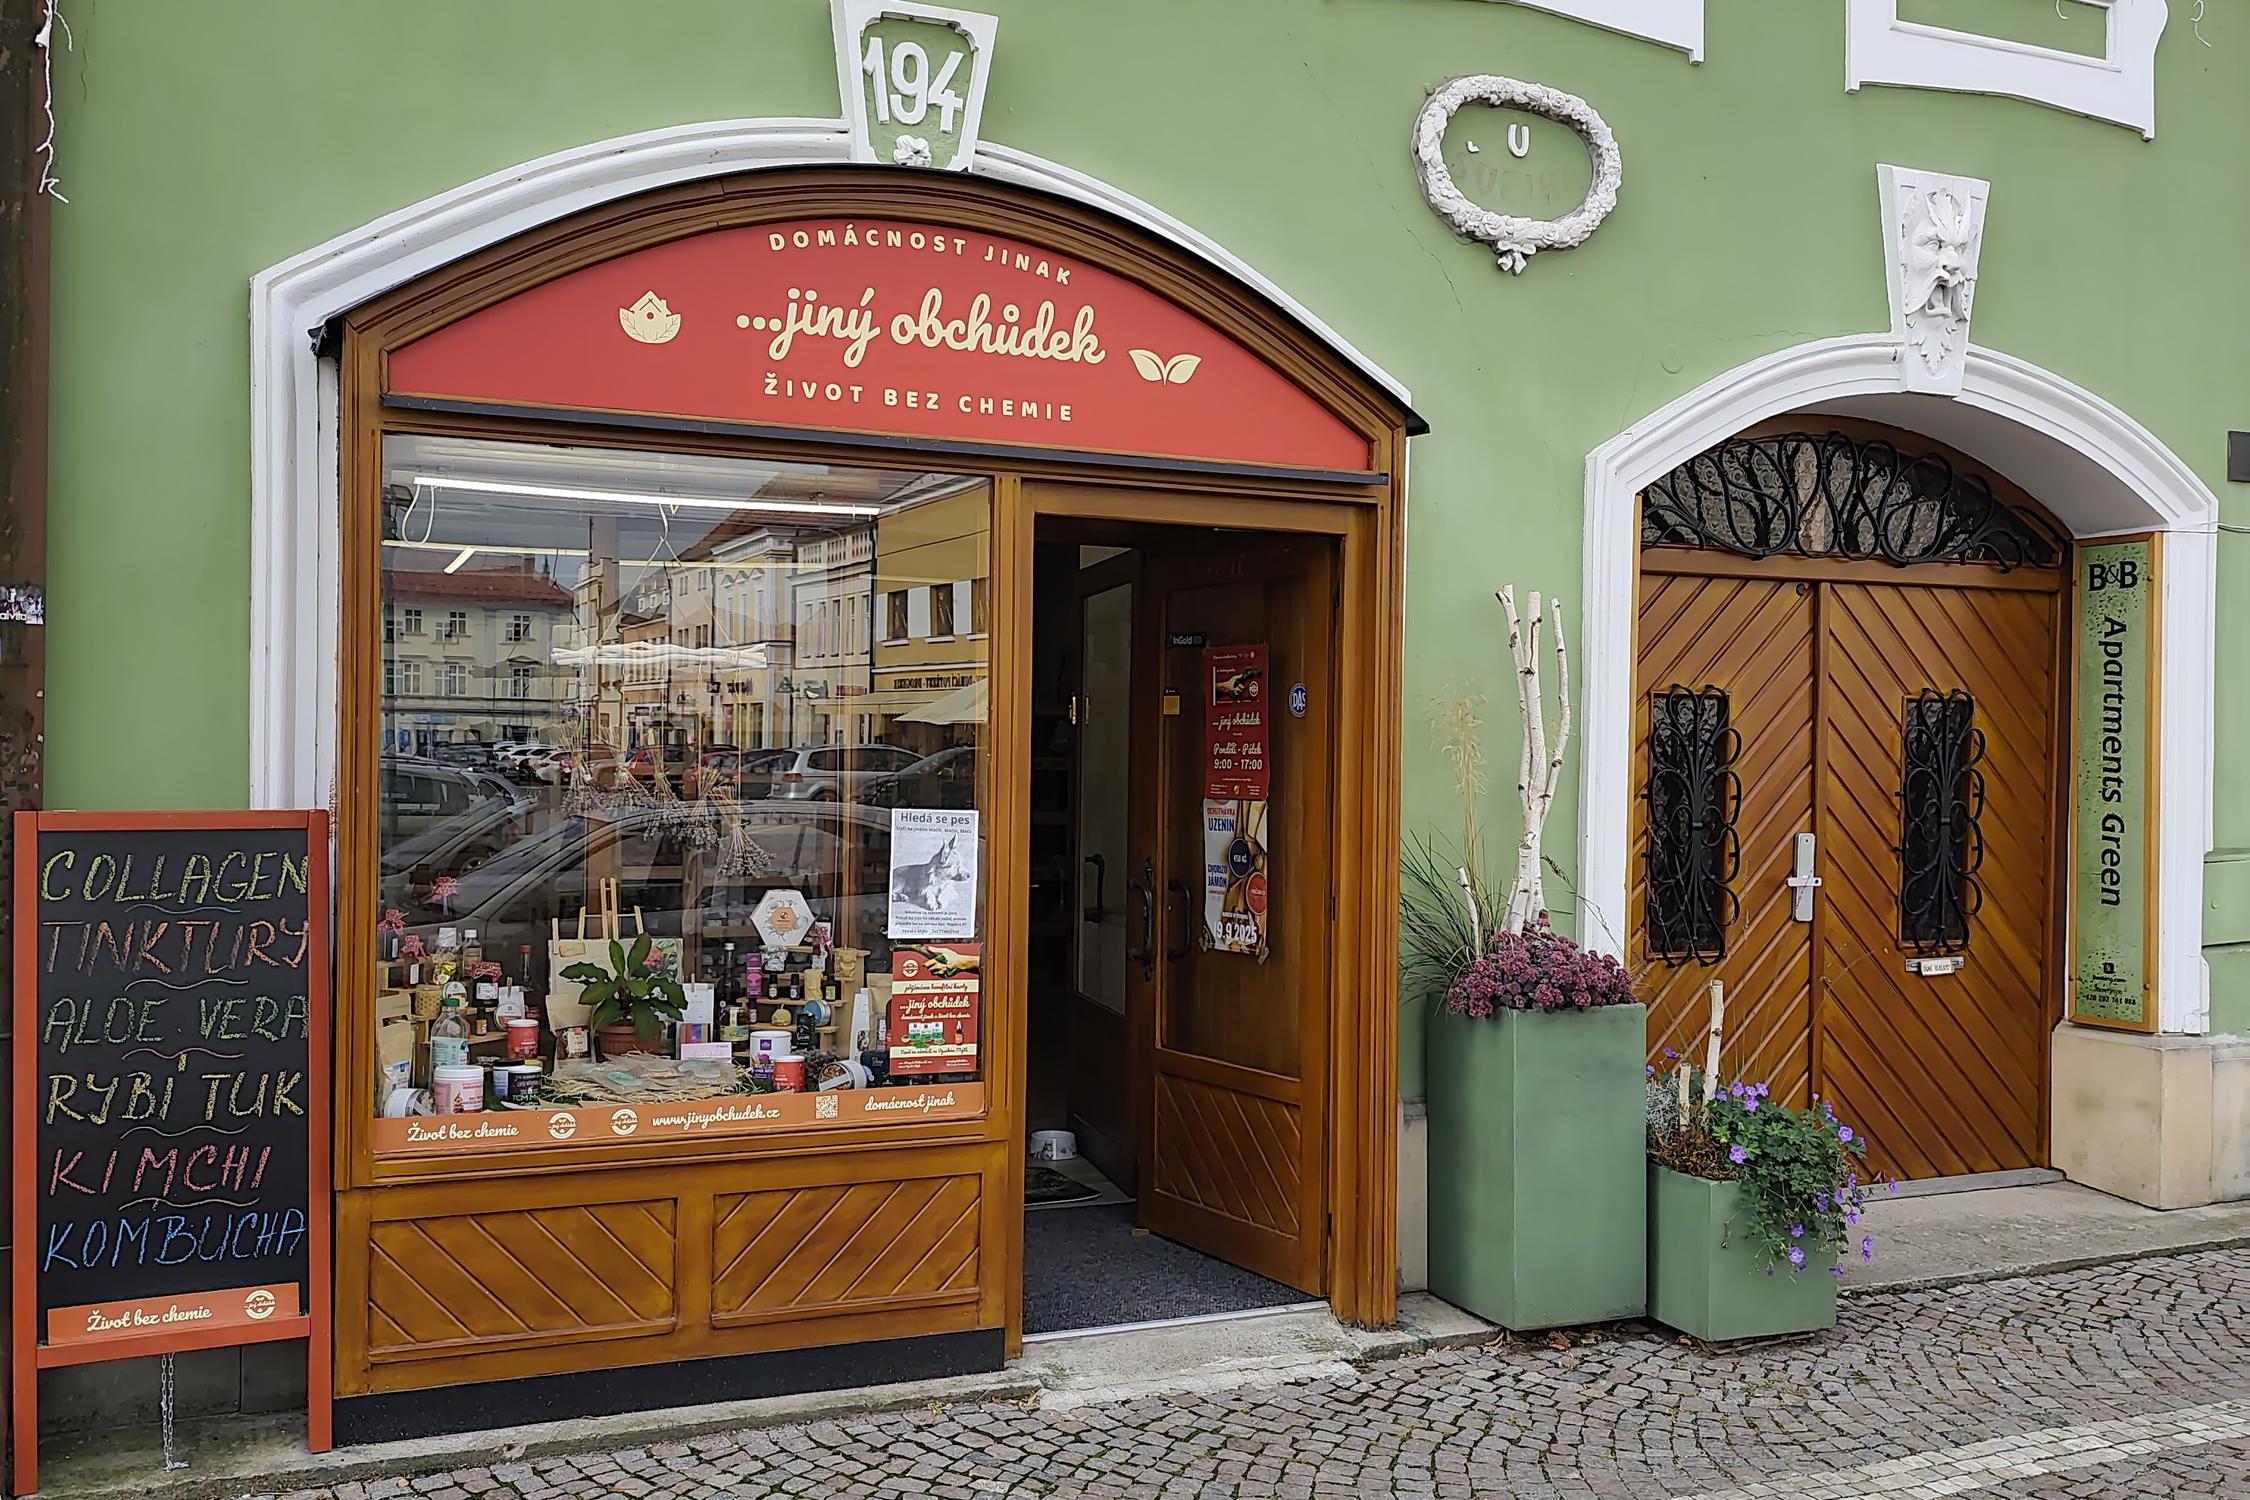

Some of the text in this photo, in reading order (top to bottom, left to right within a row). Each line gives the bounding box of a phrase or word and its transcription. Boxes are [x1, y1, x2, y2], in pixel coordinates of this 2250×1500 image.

[863, 36, 965, 134] 194
[768, 223, 1072, 286] DOMÁCNOST JINAK
[890, 287, 1106, 364] obchůdek
[763, 372, 1073, 422] ŽIVOT BEZ CHEMIE
[2087, 560, 2138, 592] B&B
[1213, 758, 1232, 769] 9:00
[1240, 758, 1263, 770] 17:00
[2098, 615, 2128, 906] Apartments Green
[900, 812, 970, 827] Hledá se pes
[41, 849, 308, 904] COLLAGEN
[42, 917, 309, 976] TINKTURY
[43, 995, 309, 1054] ALOE VERA
[927, 995, 971, 1010] obchůdek
[46, 1051, 304, 1126] RYBÍ TUK
[864, 1091, 956, 1114] domácnost jinak
[407, 1121, 520, 1142] Život bez chemie
[651, 1104, 781, 1131] www.jinyobchudek.cz
[48, 1144, 272, 1197] KIMCHI
[42, 1206, 307, 1274] KOMBUCHA
[86, 1303, 213, 1334] Život bez chemie
